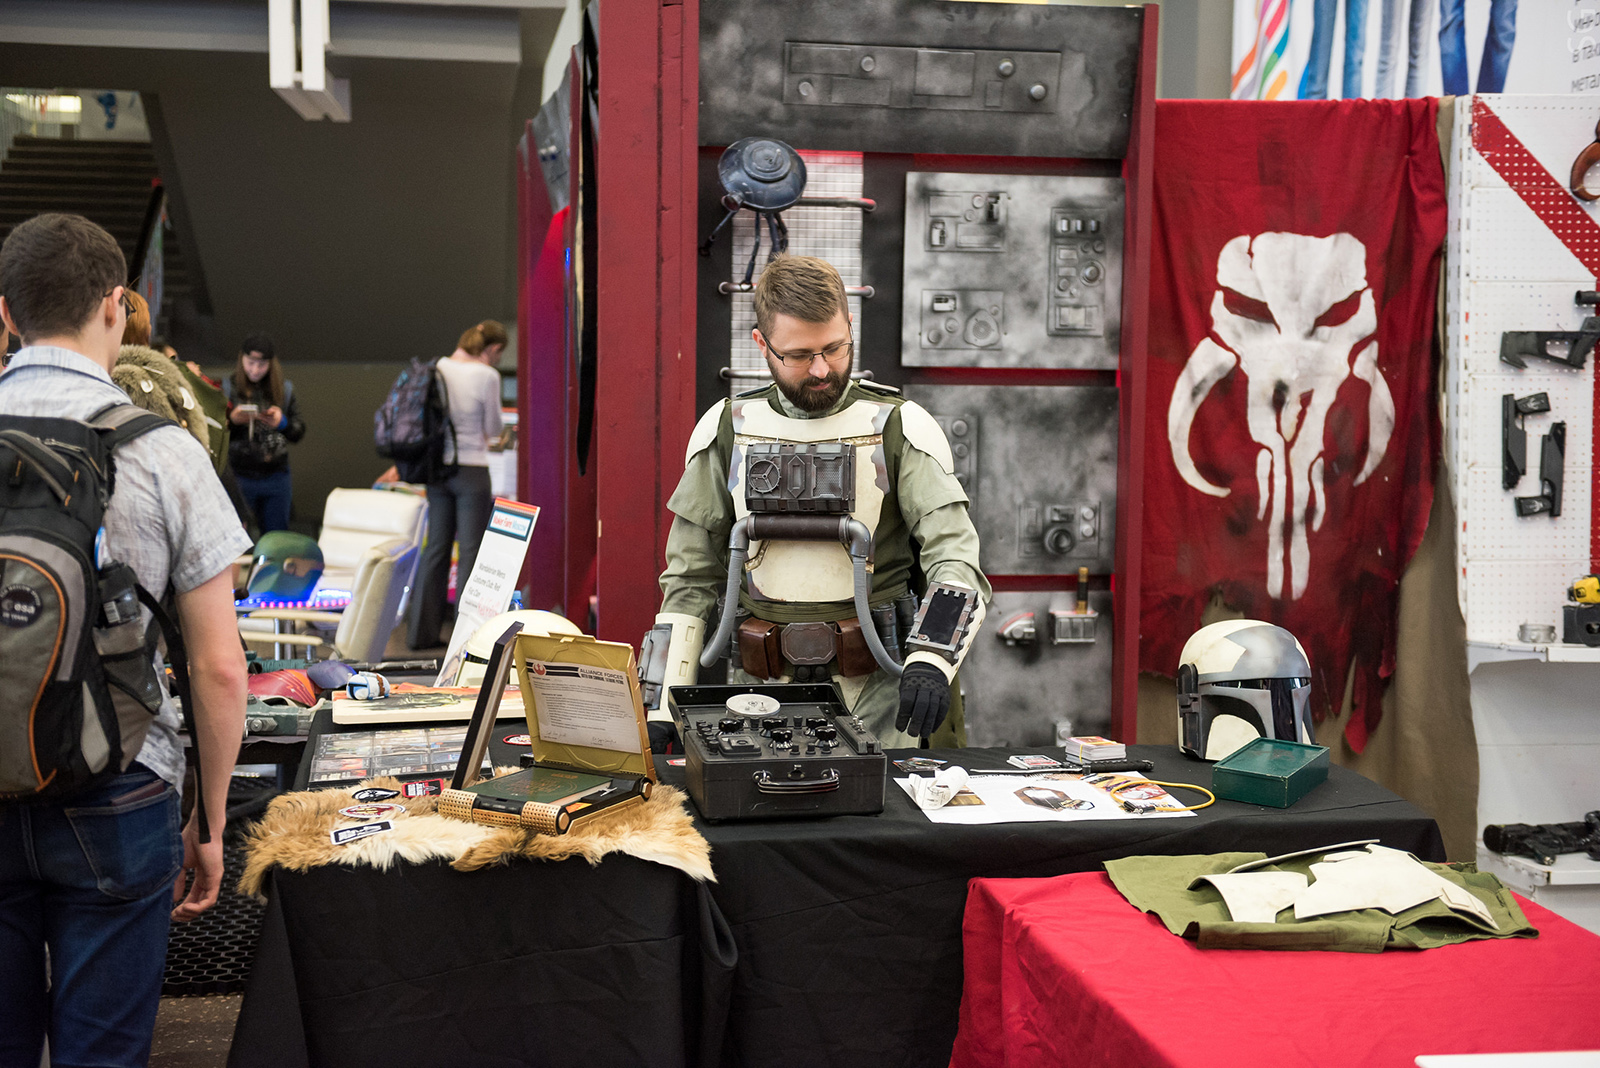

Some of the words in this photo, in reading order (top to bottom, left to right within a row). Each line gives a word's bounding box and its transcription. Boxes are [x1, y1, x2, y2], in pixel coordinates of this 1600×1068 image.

[14, 603, 35, 614] esa
[579, 668, 603, 677] ALLIANCE
[603, 672, 624, 680] FORCES
